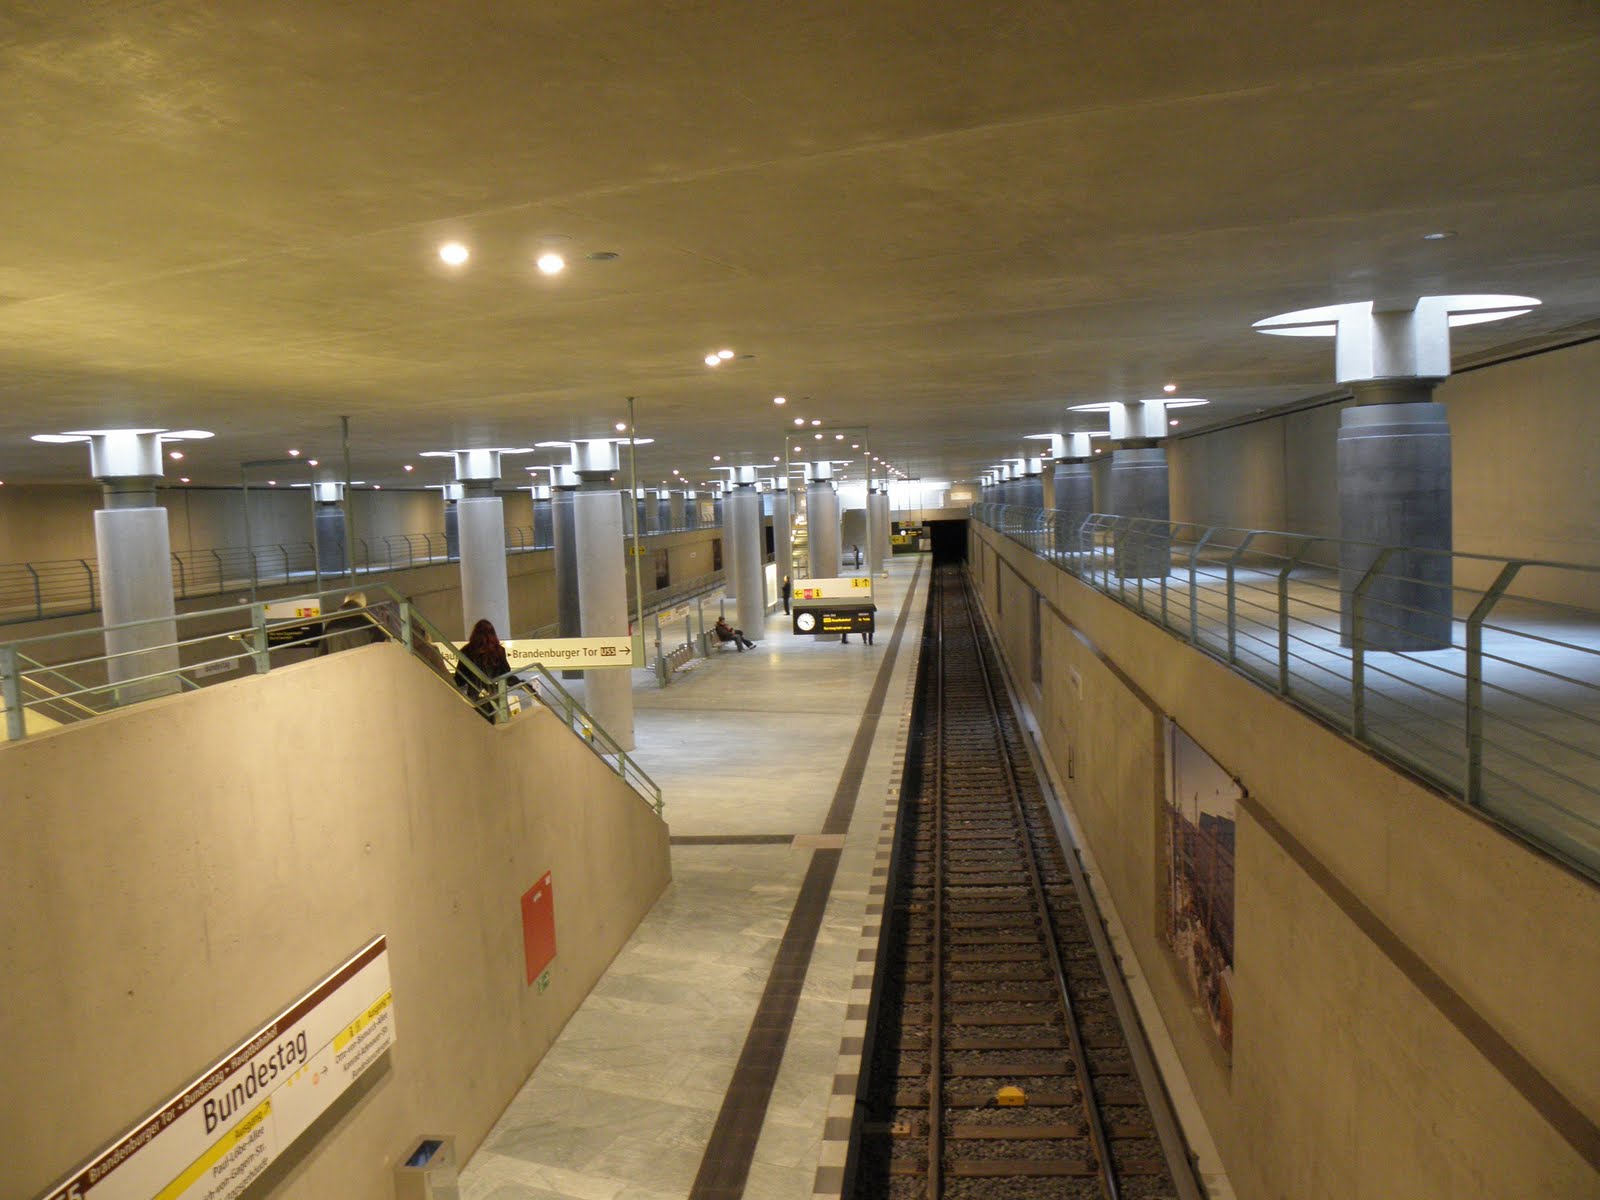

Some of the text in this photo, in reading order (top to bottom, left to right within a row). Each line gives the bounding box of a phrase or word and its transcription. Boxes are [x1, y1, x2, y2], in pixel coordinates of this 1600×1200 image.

[512, 648, 580, 660] Brandenburger
[582, 647, 597, 657] Tor
[89, 1121, 160, 1183] Brandenburger
[161, 1108, 175, 1125] Tor
[183, 1071, 224, 1107] Bundestag
[203, 1030, 307, 1136] Bundestag
